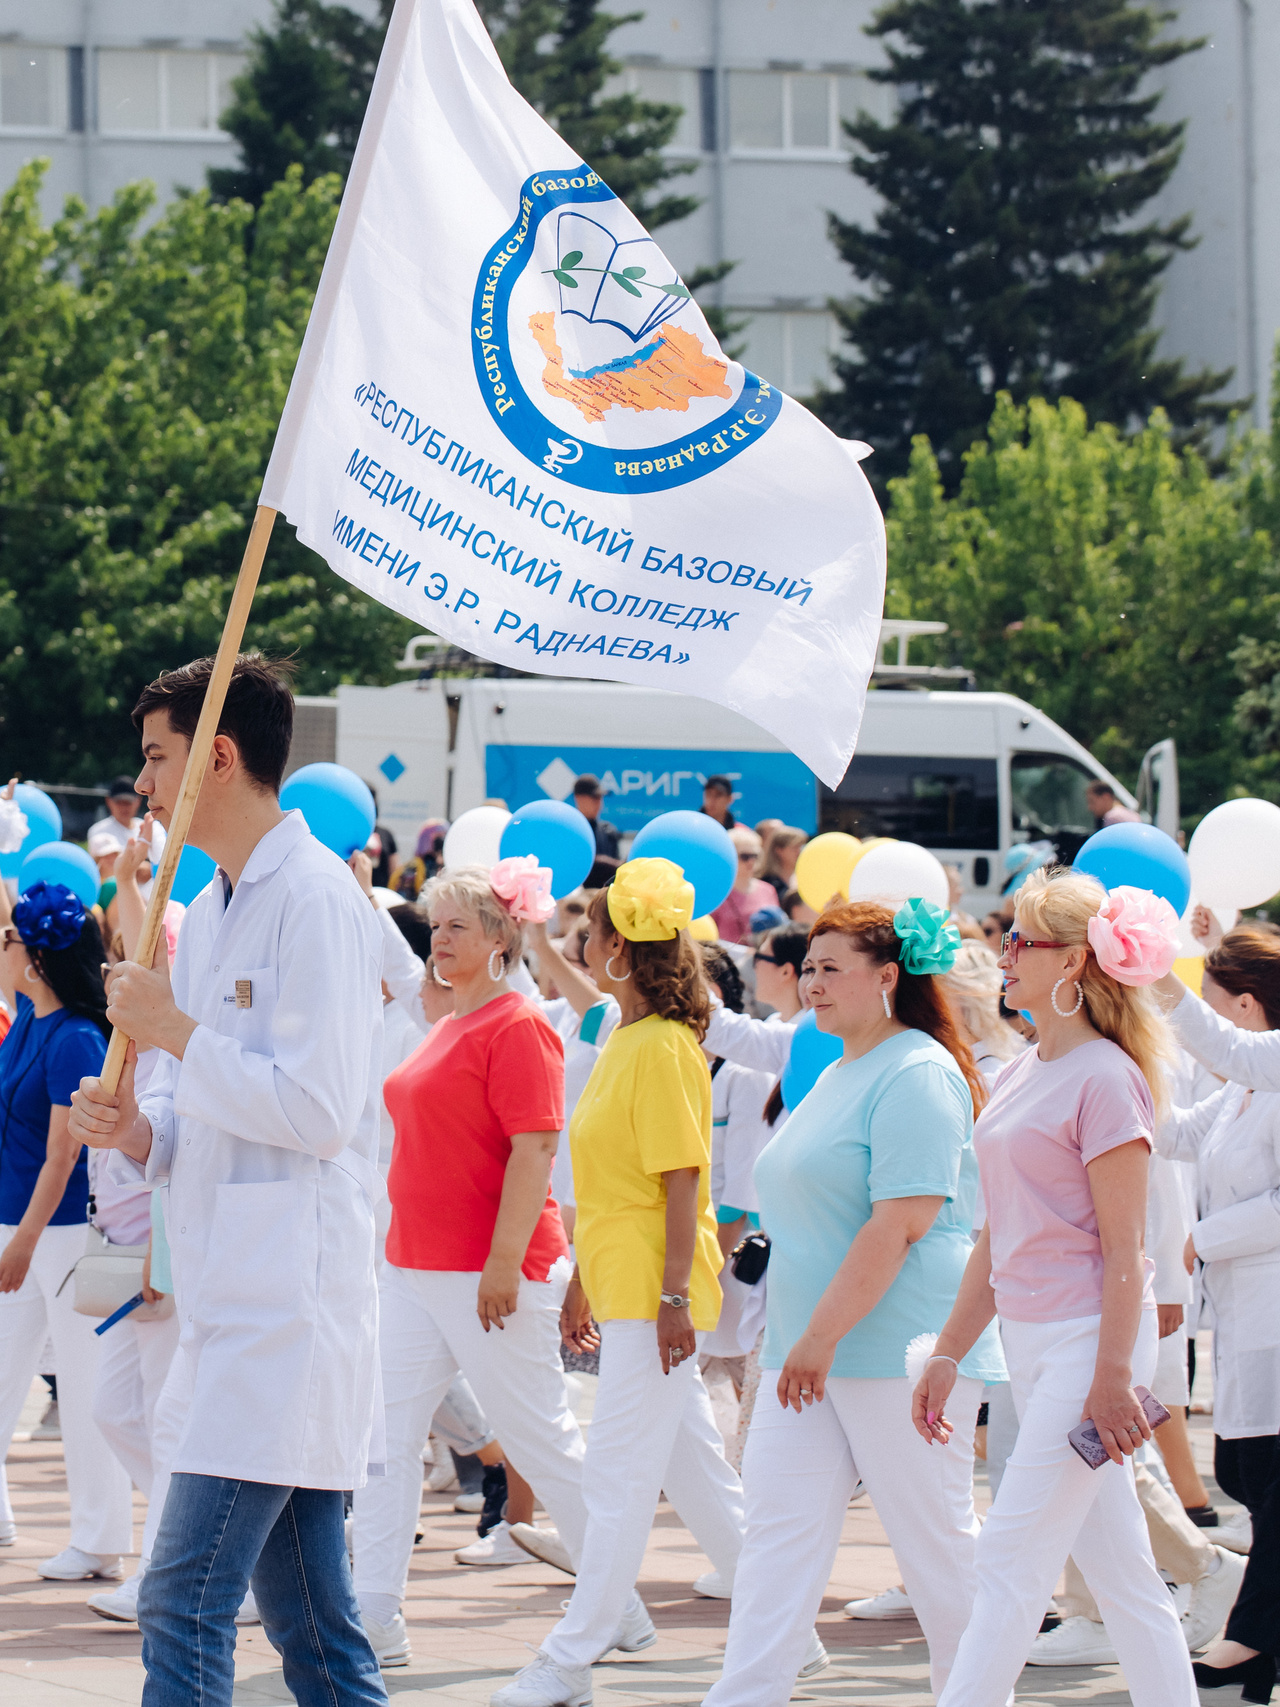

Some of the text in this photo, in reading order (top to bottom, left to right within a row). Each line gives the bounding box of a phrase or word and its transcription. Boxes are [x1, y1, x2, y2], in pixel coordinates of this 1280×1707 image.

[475, 170, 604, 417] Республиканский базов
[345, 448, 740, 631] МЕДИЦИНСКИЙ КОЛЛЕДЖ
[353, 381, 814, 606] «РЕСПУБЛИКАНСКИЙ БАЗОВЫЙ
[332, 509, 690, 665] ИМЕНИ Э.Р. РАДНАЕВА»
[599, 769, 742, 797] АРИГ
